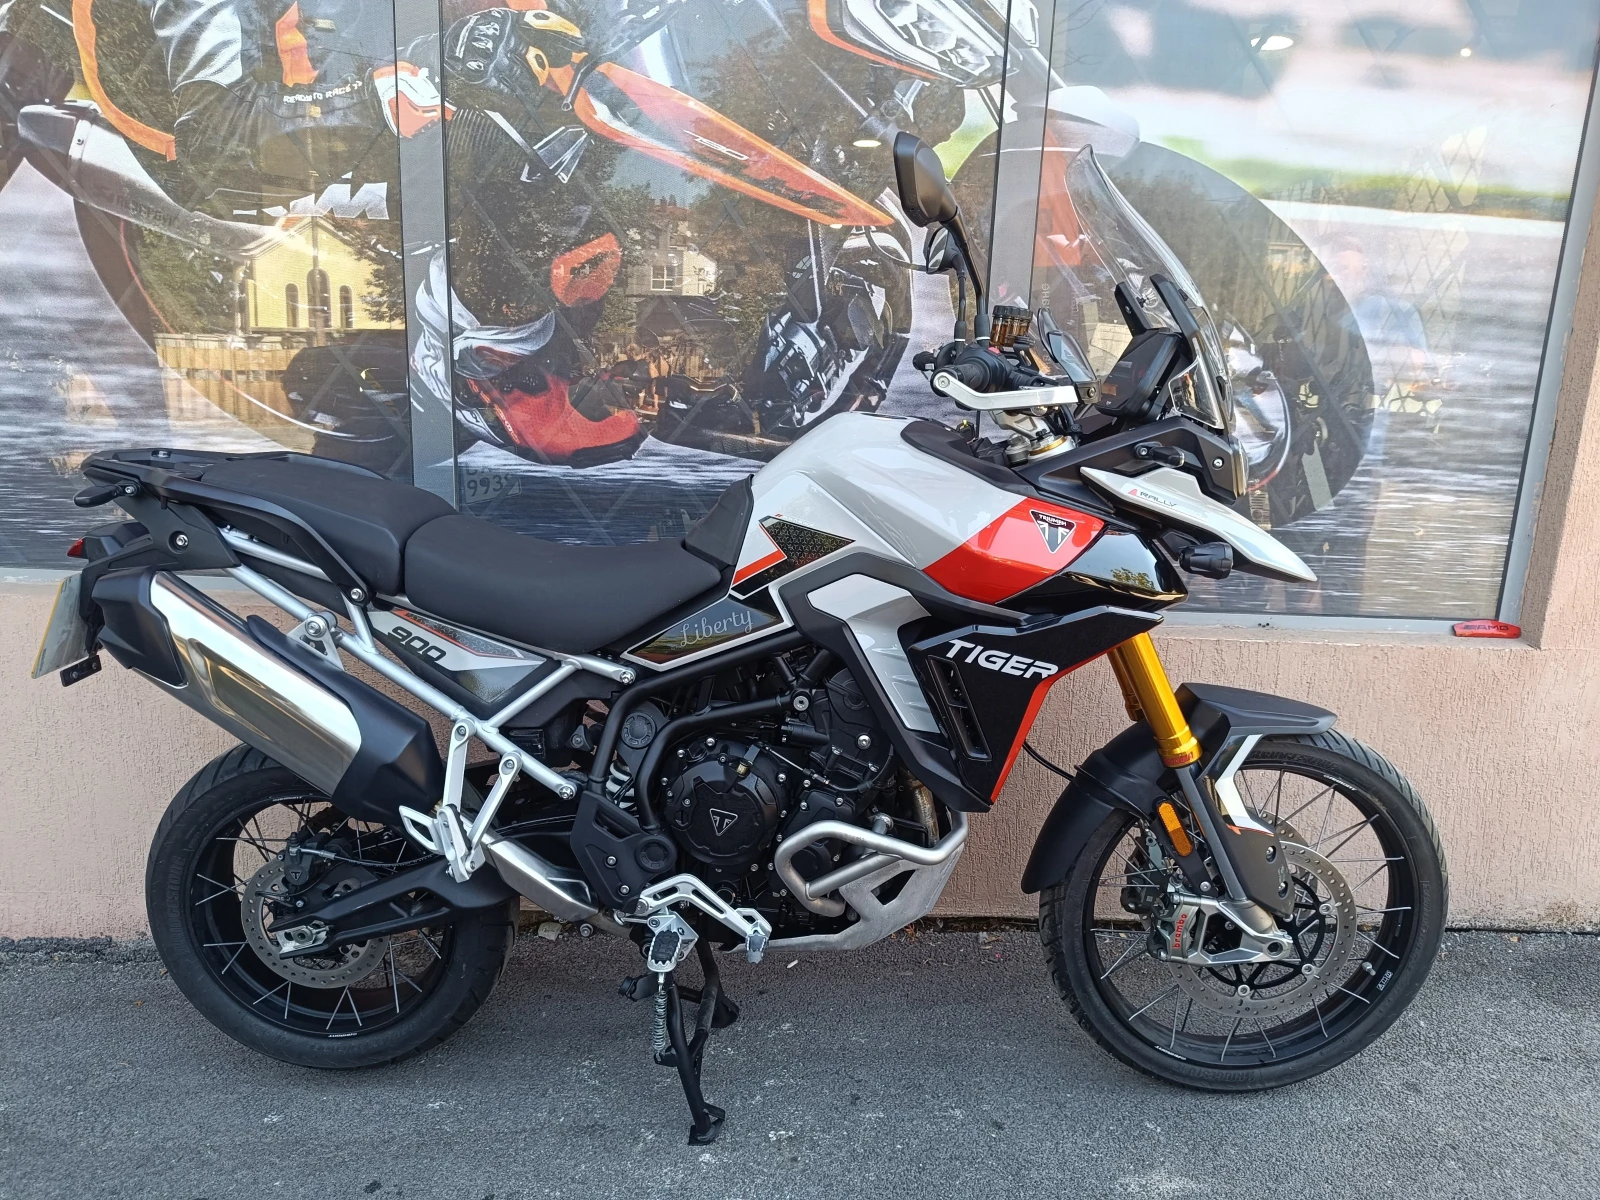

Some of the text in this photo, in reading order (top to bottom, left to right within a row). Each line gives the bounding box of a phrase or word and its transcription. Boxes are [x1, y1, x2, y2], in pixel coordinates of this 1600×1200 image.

[1140, 491, 1178, 507] RALLY
[1039, 513, 1067, 526] TRIUMPH
[388, 626, 447, 665] 900
[680, 610, 754, 648] Liberty
[945, 639, 1059, 679] TIGER
[1172, 913, 1187, 949] brembo
